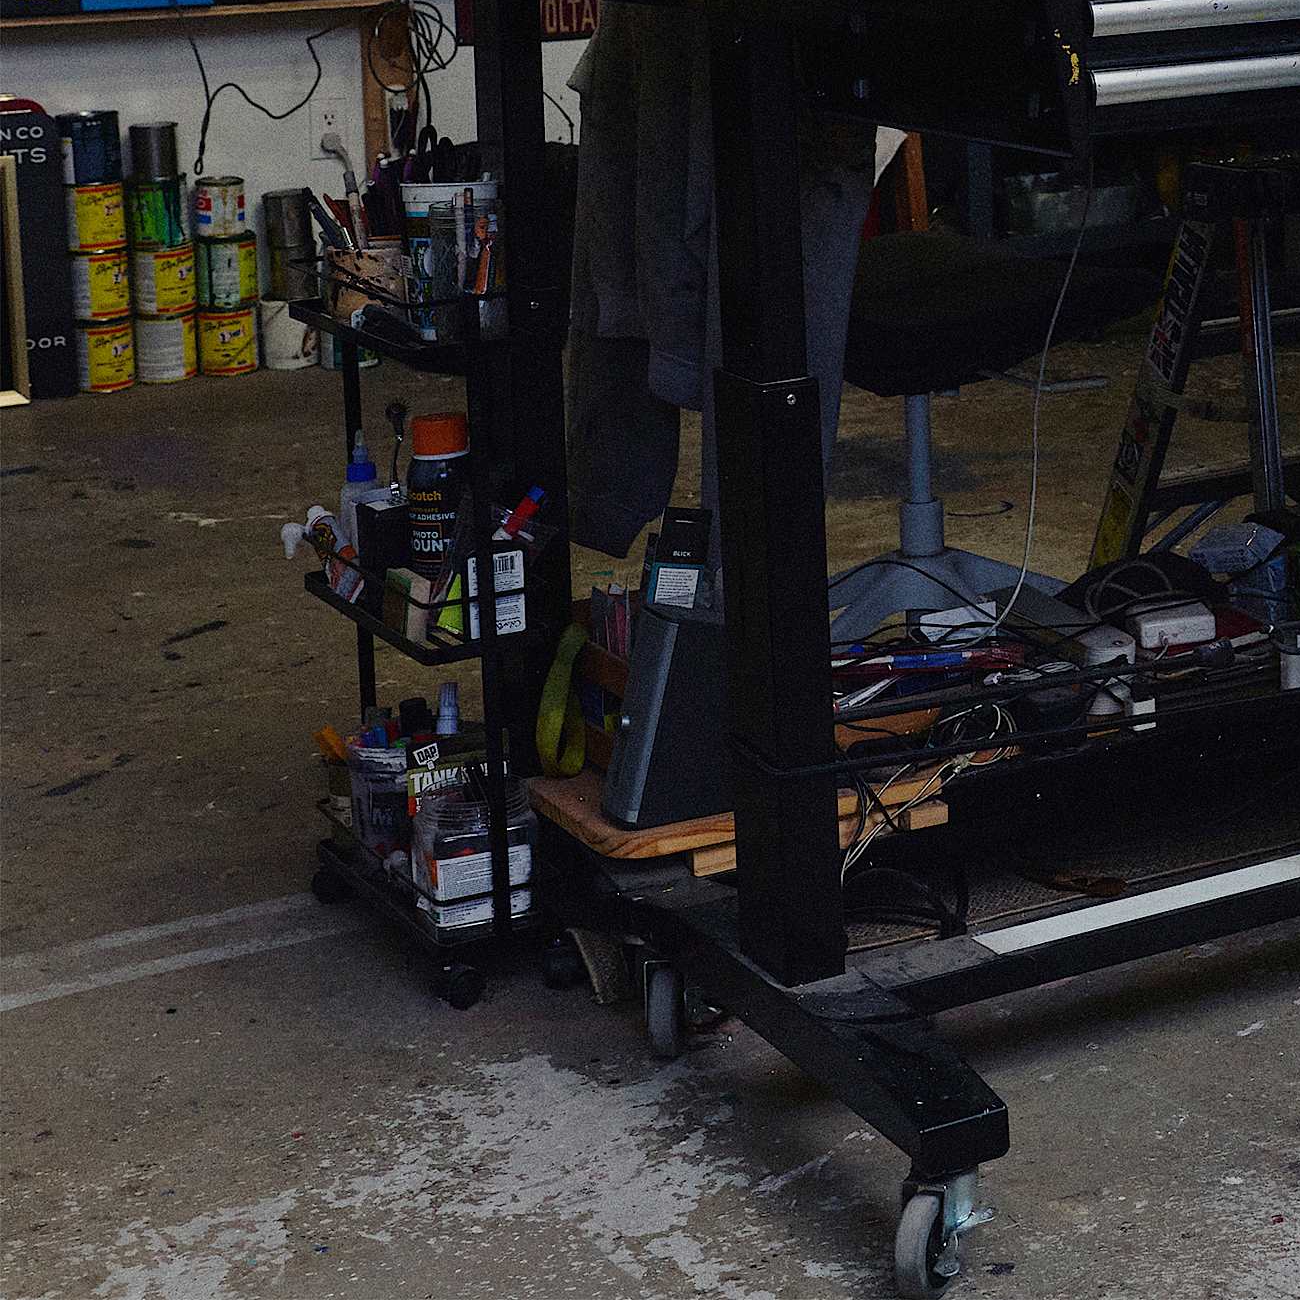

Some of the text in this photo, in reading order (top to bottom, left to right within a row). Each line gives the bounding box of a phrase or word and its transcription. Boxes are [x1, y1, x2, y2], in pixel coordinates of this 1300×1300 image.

[16, 126, 44, 140] CO
[4, 147, 48, 165] TS
[416, 745, 439, 764] DAP
